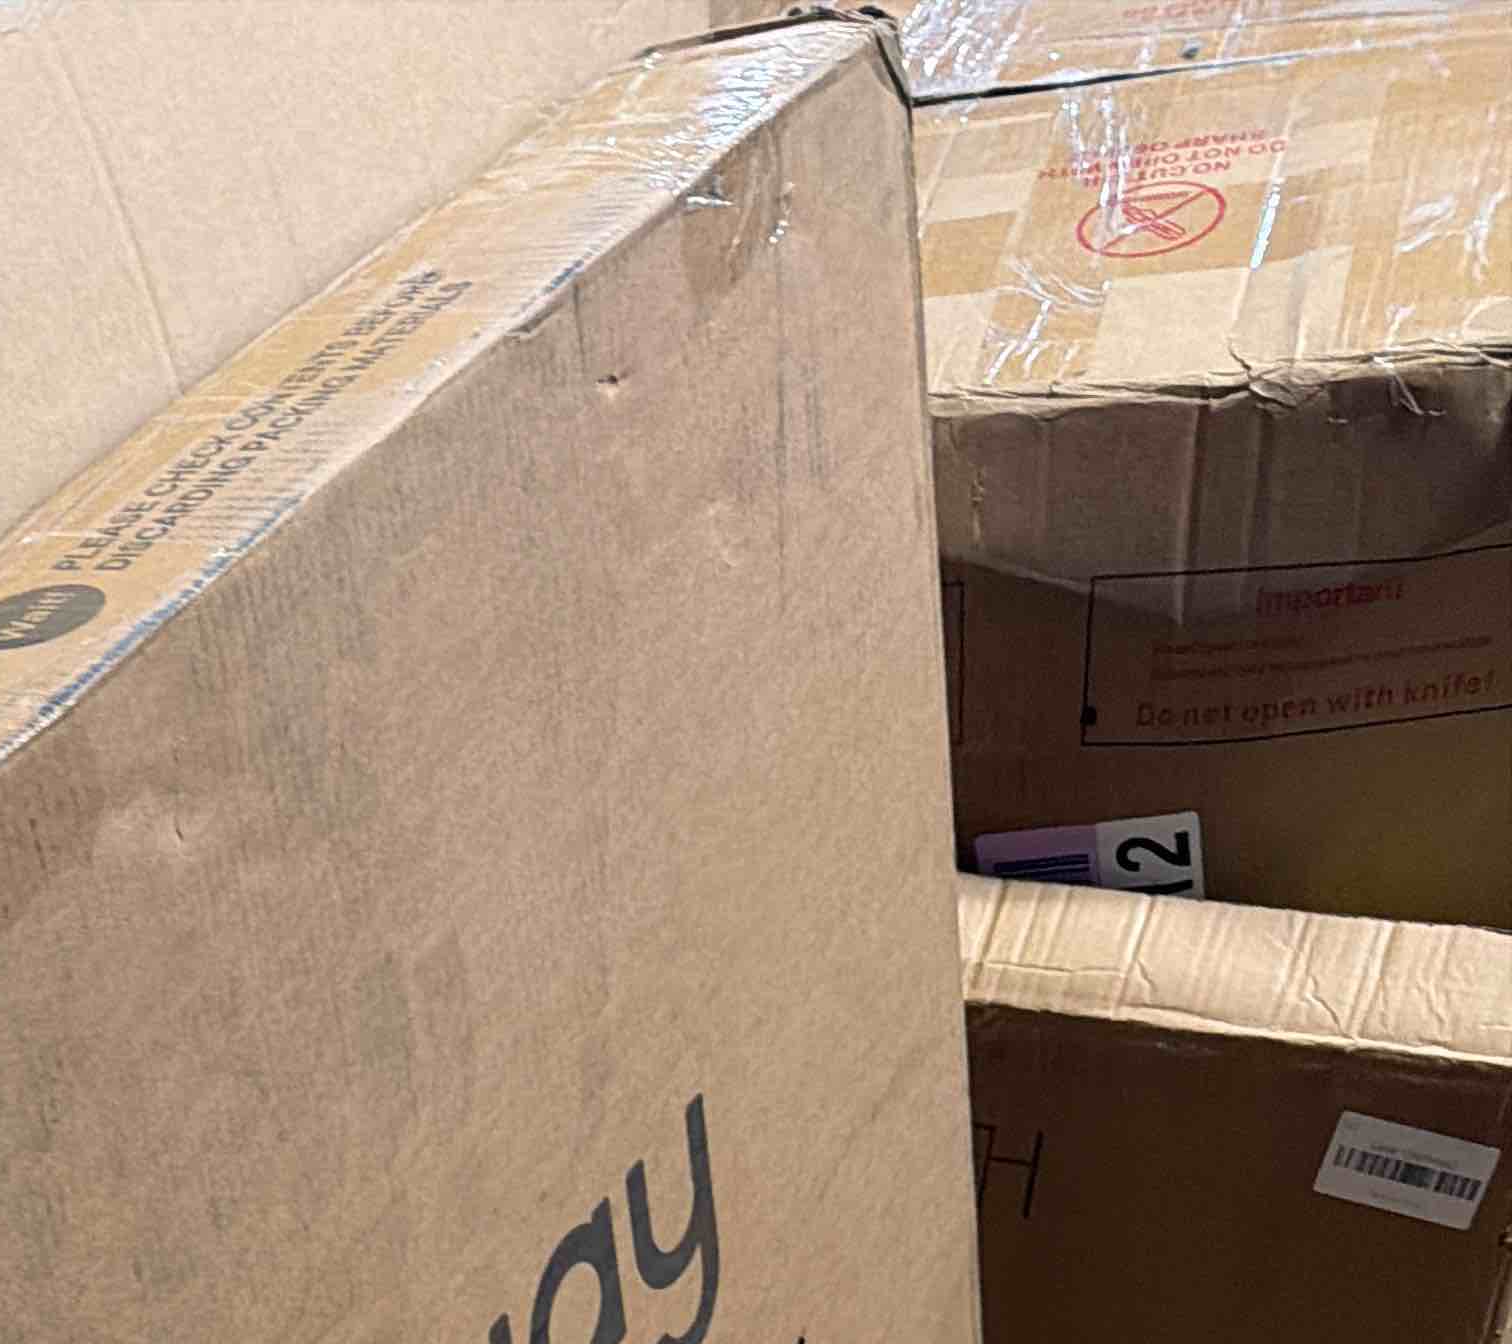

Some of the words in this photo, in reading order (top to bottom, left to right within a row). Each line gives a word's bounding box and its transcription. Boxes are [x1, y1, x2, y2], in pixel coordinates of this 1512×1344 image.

[1190, 146, 1239, 162] NOT
[1248, 140, 1287, 156] DO
[1192, 160, 1231, 176] NO
[93, 455, 258, 570] DISCARDING
[239, 374, 360, 452] PACKING
[53, 501, 156, 570] PLEASE
[144, 436, 233, 498] CHECK
[1135, 702, 1177, 729] Do
[1240, 698, 1318, 738] open
[1327, 683, 1395, 715] with
